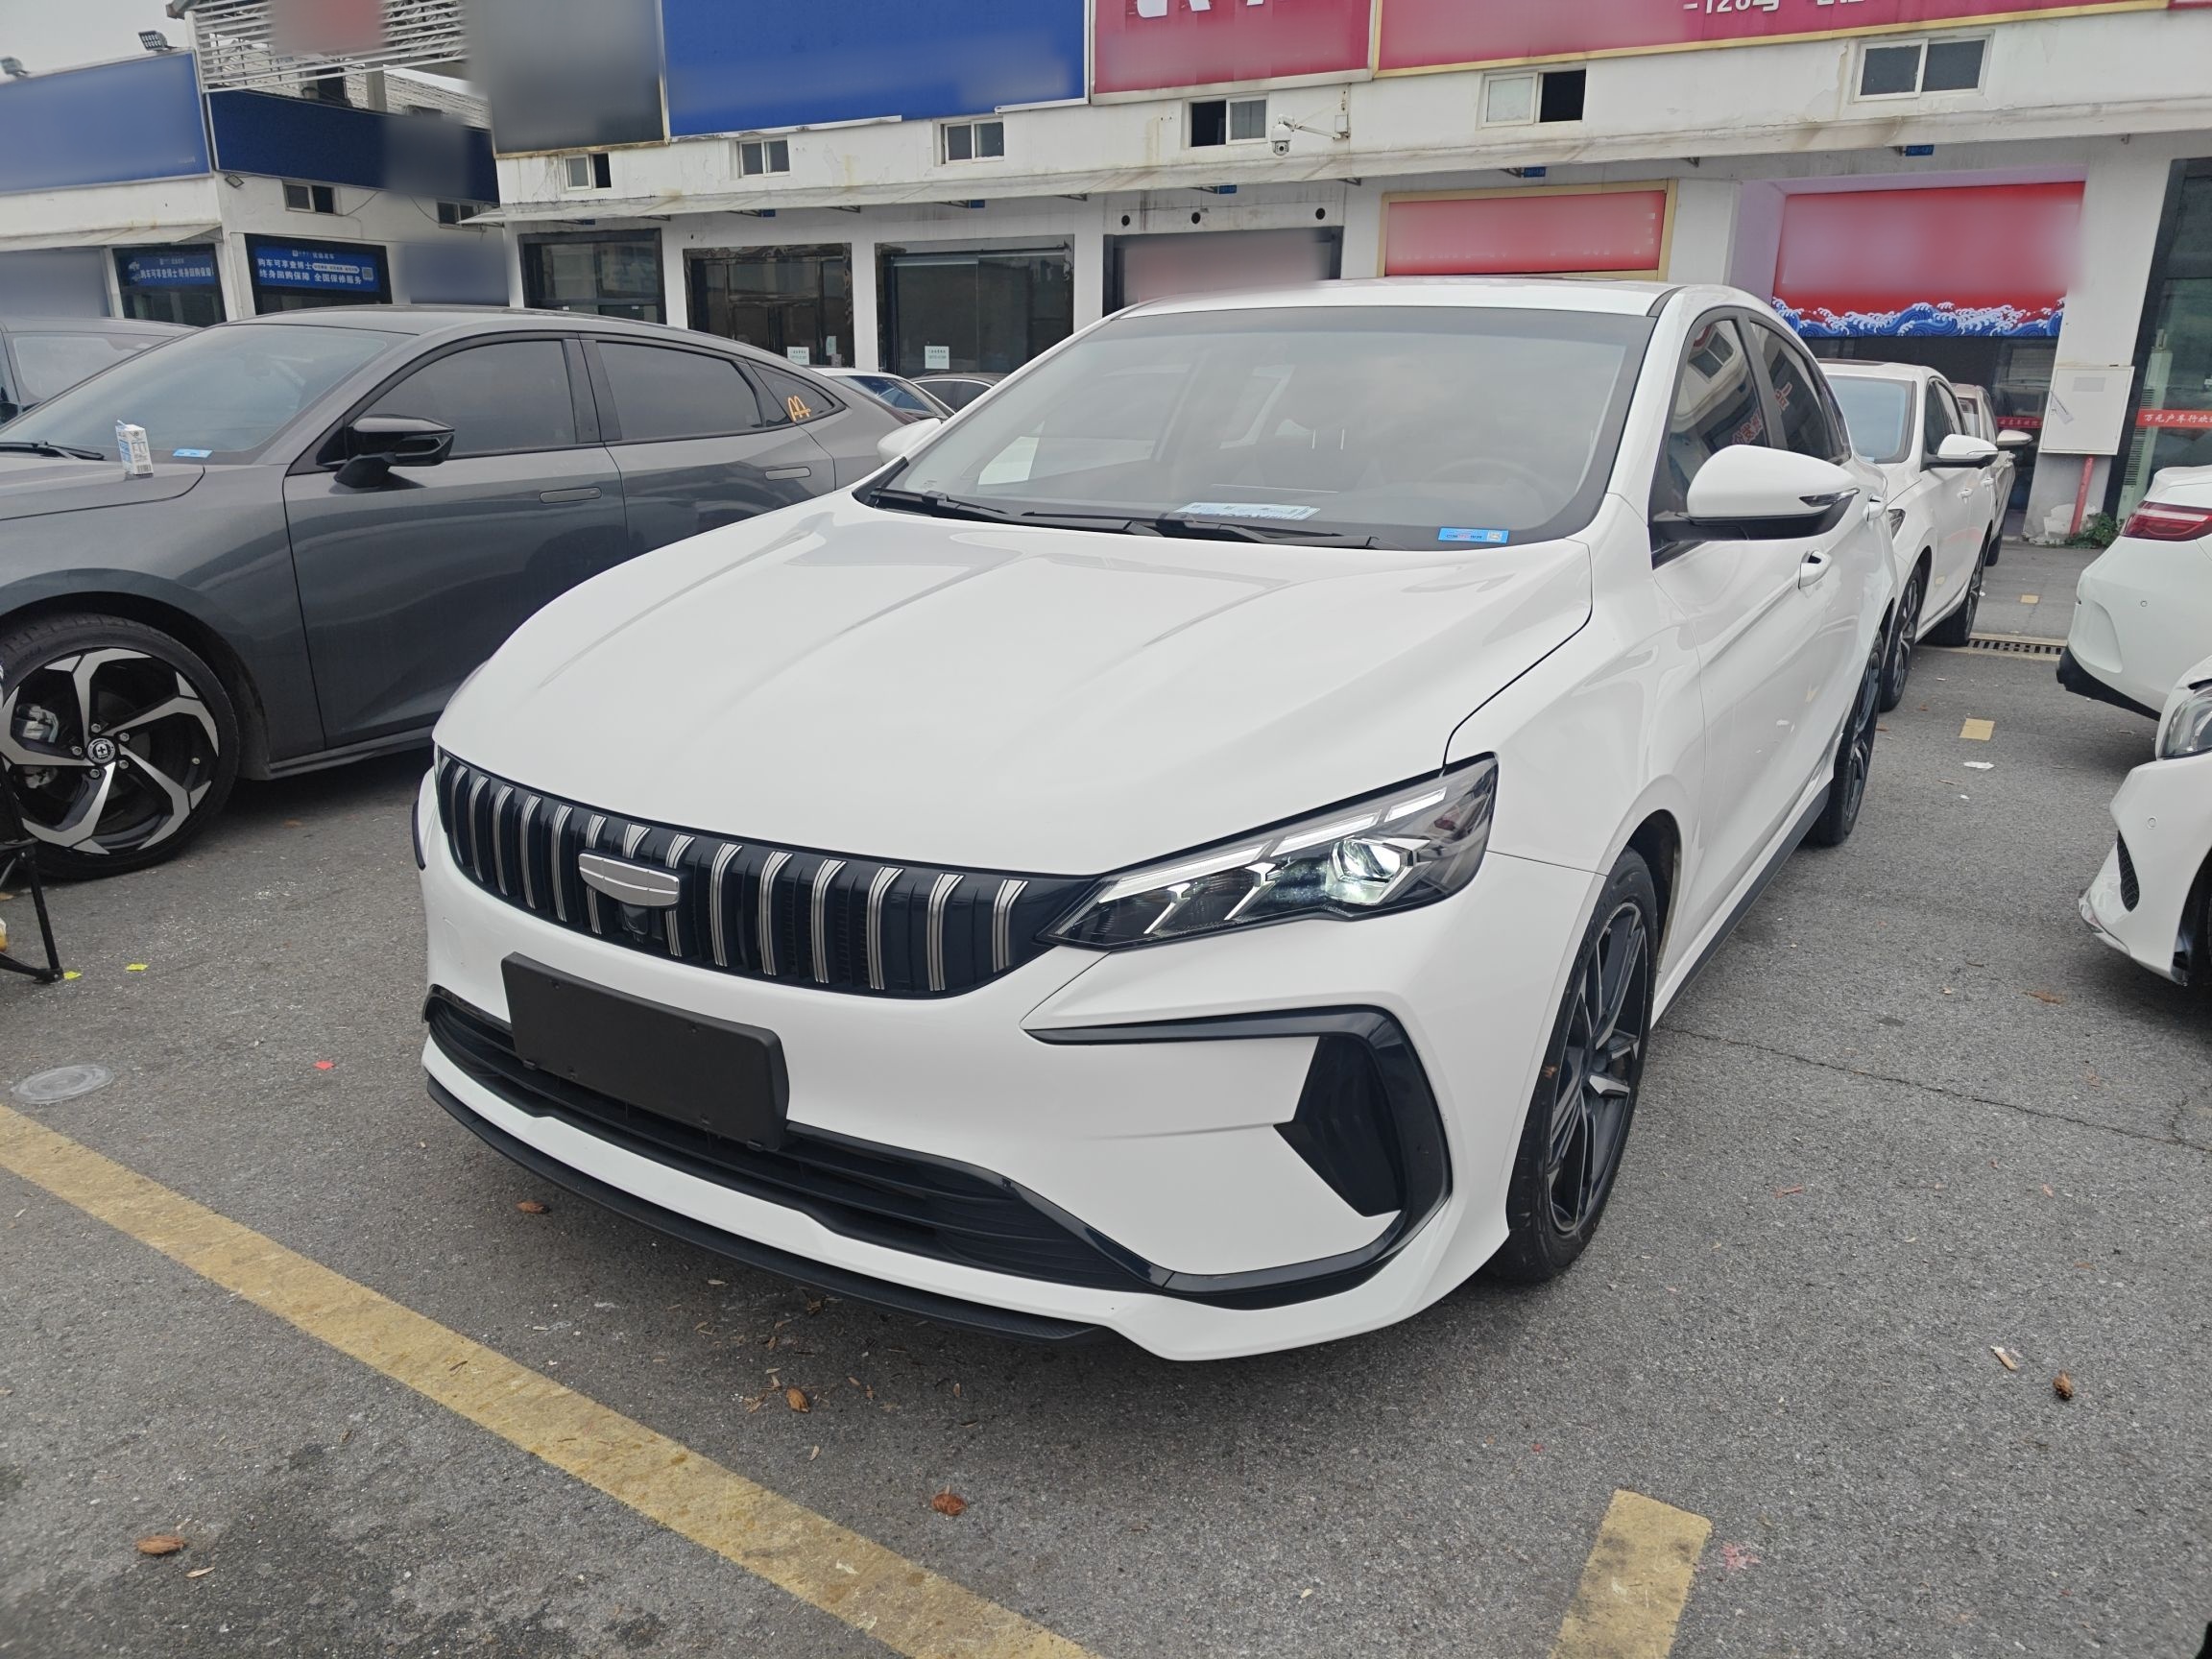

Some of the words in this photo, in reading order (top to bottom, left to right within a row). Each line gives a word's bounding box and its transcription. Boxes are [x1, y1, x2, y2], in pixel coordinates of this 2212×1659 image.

[314, 275, 362, 285] 全国保修服务
